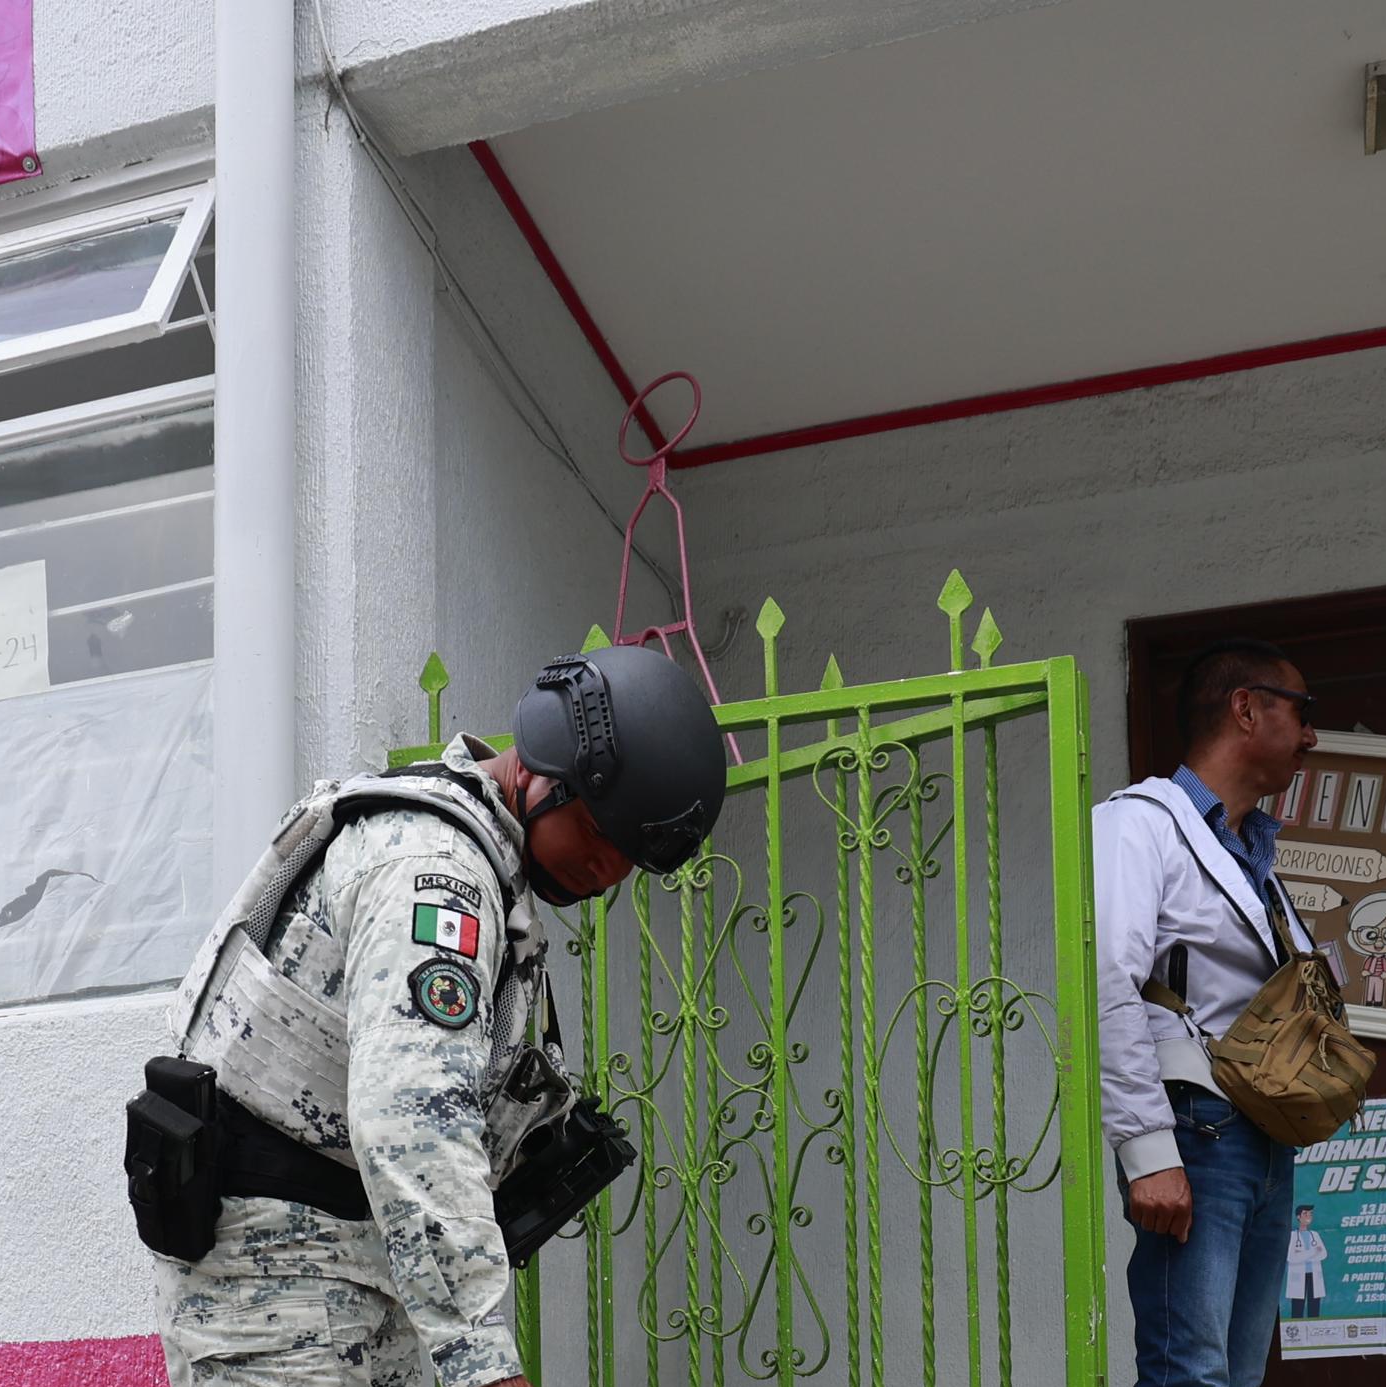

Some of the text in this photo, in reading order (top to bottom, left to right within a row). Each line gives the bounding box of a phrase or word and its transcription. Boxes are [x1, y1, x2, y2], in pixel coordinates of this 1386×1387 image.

[421, 876, 477, 901] MEXICO
[1318, 1165, 1362, 1193] DE
[1360, 1203, 1376, 1215] 13
[1344, 1234, 1376, 1245] PLAZA
[1342, 1273, 1350, 1282] A
[1351, 1272, 1384, 1282] PARTIR
[1356, 1294, 1363, 1303] A
